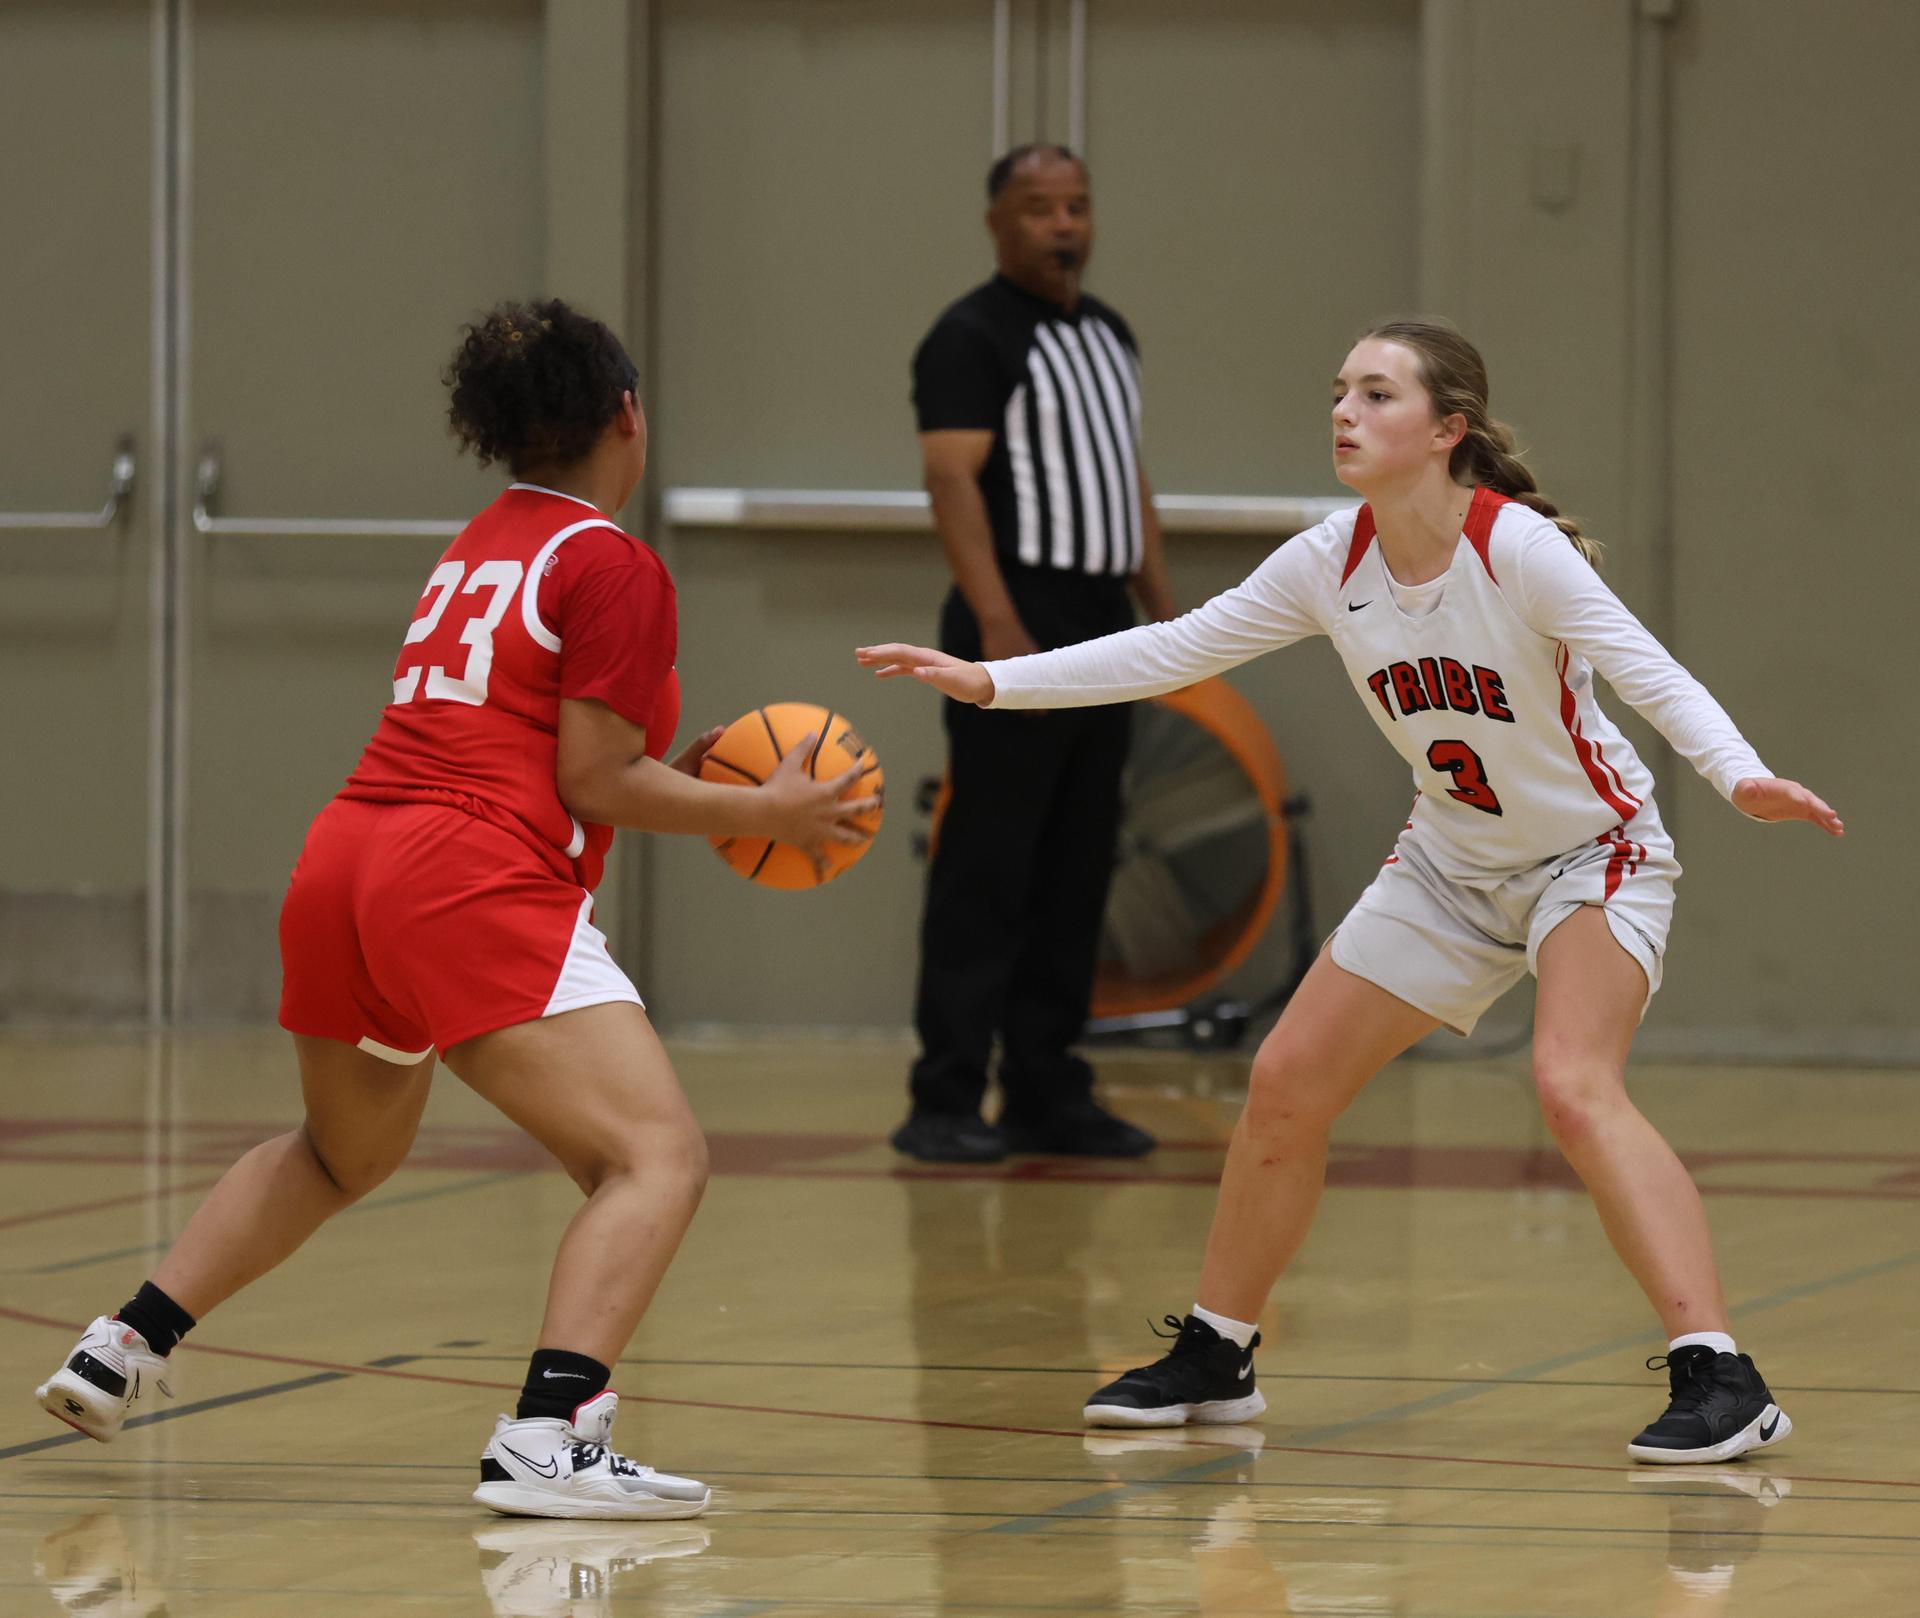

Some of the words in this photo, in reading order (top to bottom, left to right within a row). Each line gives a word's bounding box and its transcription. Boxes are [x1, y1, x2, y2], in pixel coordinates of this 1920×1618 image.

[392, 560, 524, 706] 23
[1367, 656, 1516, 723] TRIBE
[1426, 740, 1502, 817] 3
